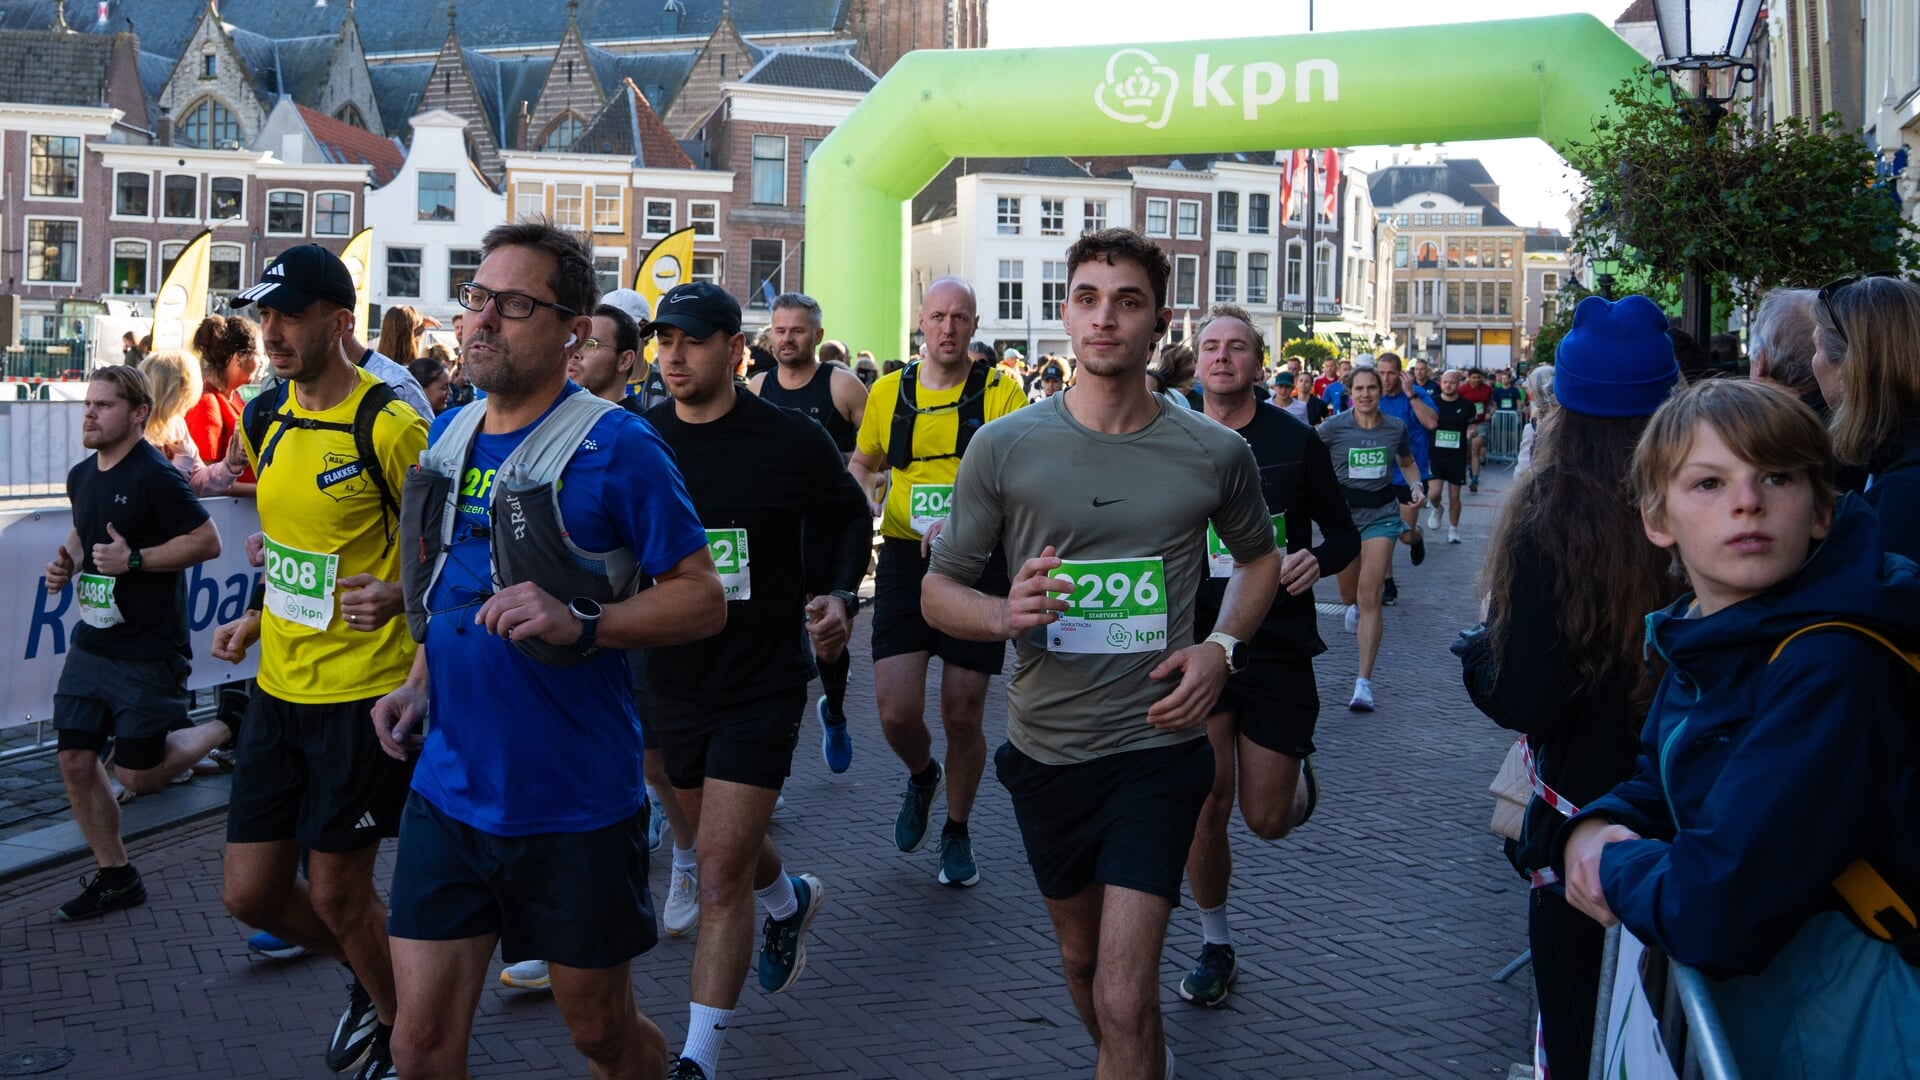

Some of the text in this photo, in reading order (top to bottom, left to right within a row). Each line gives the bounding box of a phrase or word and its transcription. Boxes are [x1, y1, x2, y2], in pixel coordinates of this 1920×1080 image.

[1192, 53, 1339, 120] kpn
[1439, 433, 1456, 441] 2413
[1353, 452, 1384, 465] 1852
[323, 464, 358, 484] FLAKKEE
[80, 581, 106, 604] 2488
[1054, 571, 1159, 608] 2296
[301, 605, 323, 620] kpn
[1135, 629, 1165, 644] kpn
